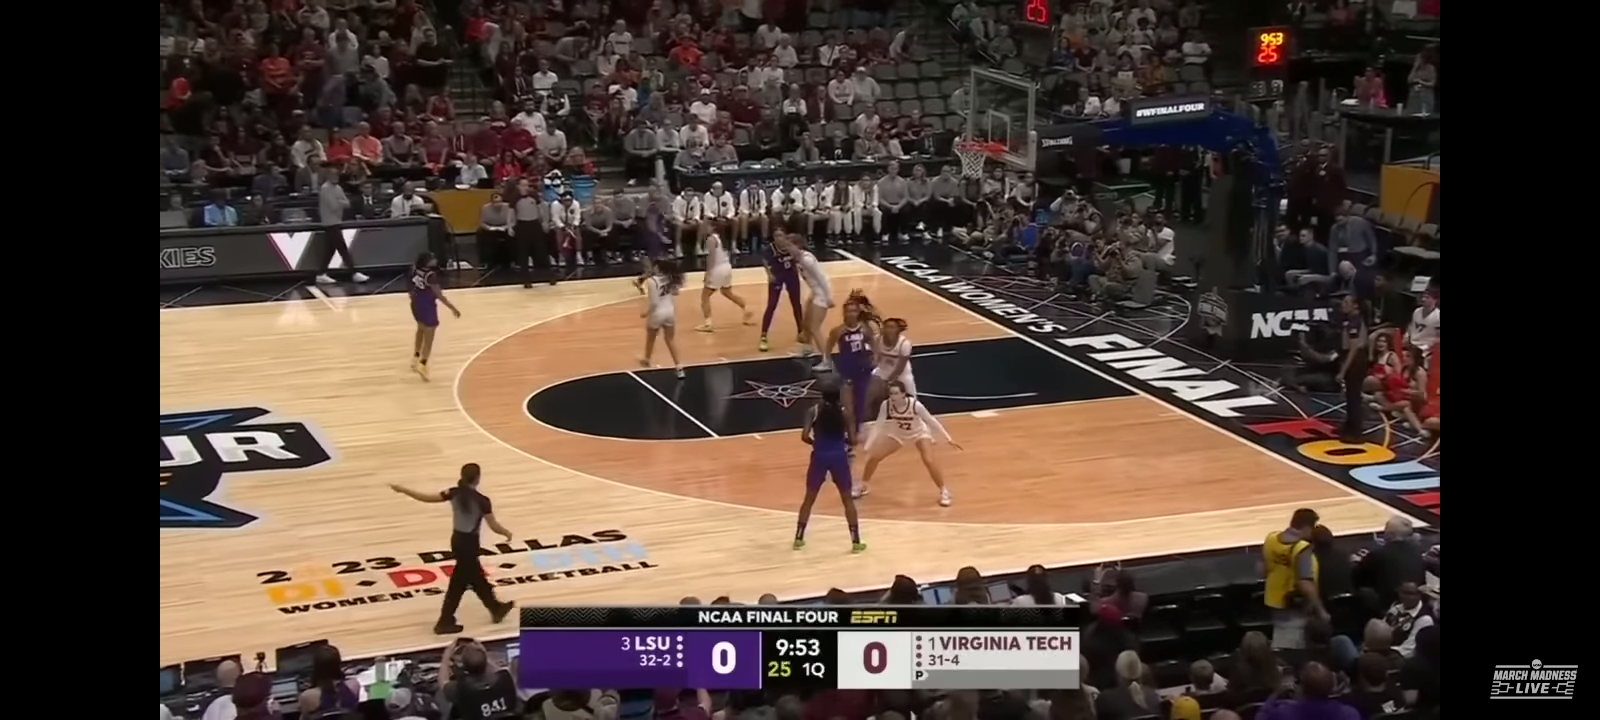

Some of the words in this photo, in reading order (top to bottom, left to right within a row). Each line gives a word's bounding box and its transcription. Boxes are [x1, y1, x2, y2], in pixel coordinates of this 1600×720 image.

[1258, 46, 1278, 62] 25
[1136, 103, 1205, 118] #WFINALFOUR
[880, 256, 952, 283] NCAA
[940, 281, 1067, 333] WOMEN'S
[1054, 333, 1278, 417] FINAL
[277, 586, 446, 615] WOMEN'S
